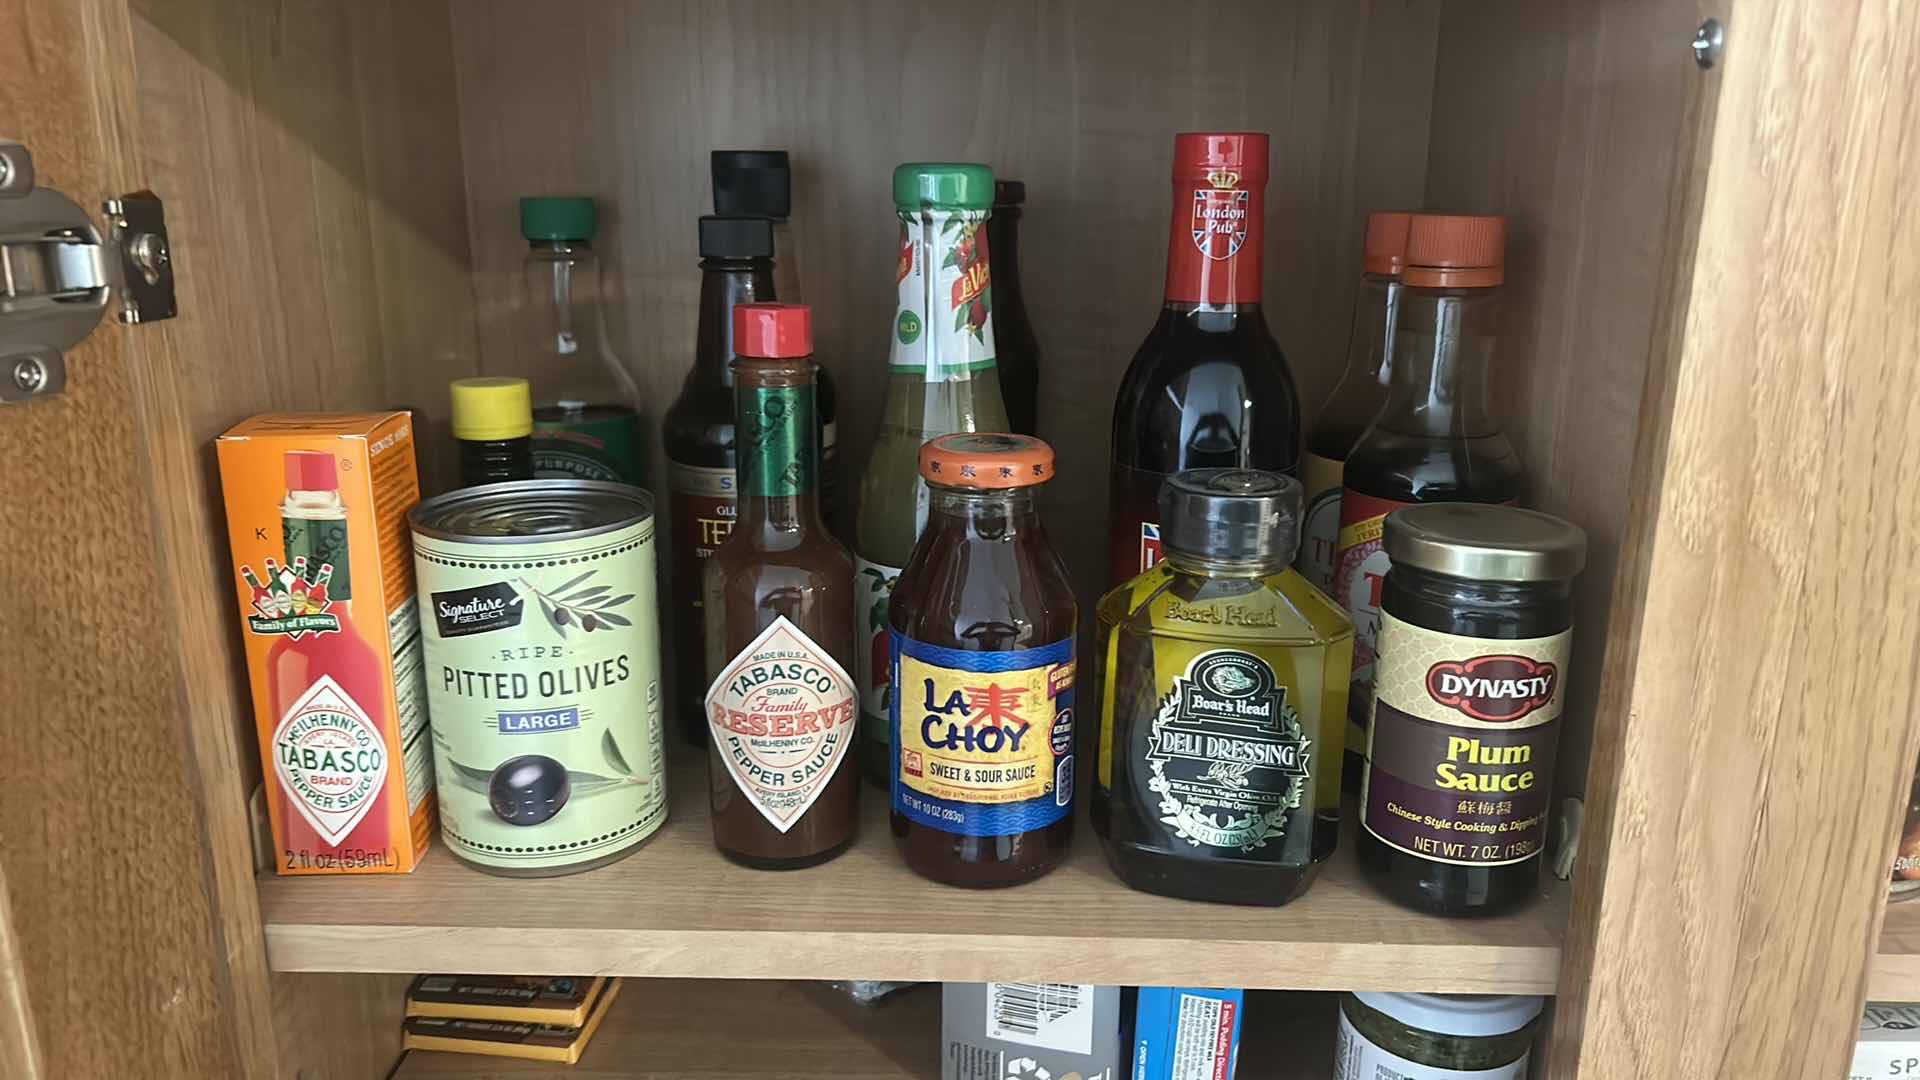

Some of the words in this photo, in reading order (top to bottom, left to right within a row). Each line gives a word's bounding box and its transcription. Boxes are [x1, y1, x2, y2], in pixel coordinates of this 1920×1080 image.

[1197, 204, 1245, 220] London
[1208, 220, 1235, 234] Pub
[255, 528, 267, 540] K
[440, 597, 506, 624] Signature
[458, 609, 505, 623] SELECT
[252, 620, 286, 632] Family
[286, 618, 298, 628] of
[299, 616, 336, 628] Flavors
[501, 646, 564, 661] RIPE
[443, 666, 528, 700] PITTED
[539, 655, 630, 697] OLIVES
[729, 664, 832, 697] TABASCO
[1440, 673, 1552, 699] DYNASTY
[766, 688, 798, 696] BRAND
[923, 678, 971, 717] LA
[752, 696, 809, 714] Family
[1192, 694, 1234, 713] Boar's
[1235, 699, 1270, 717] Head
[505, 712, 573, 730] LARGE
[712, 698, 854, 738] RESERVE
[921, 715, 1031, 754] CHOY
[279, 742, 383, 774] TABASCO
[728, 736, 785, 786] PEPPER
[792, 733, 838, 784] SAUCE
[1161, 731, 1202, 755] DELI
[1206, 736, 1295, 766] DRESSING
[1446, 736, 1531, 765] Plum
[311, 775, 353, 787] BRAND
[930, 761, 962, 781] SWEET
[964, 769, 972, 782] &
[975, 769, 1003, 783] SOUR
[1005, 764, 1036, 782] SAUCE
[1435, 763, 1535, 792] Sauce
[289, 768, 334, 809] PEPPER
[340, 776, 374, 809] SAUCE
[1213, 788, 1238, 799] Virgin
[1386, 801, 1423, 823] Chinese
[1423, 815, 1452, 831] Style
[1453, 820, 1498, 835] Cooking
[1498, 823, 1507, 832] &
[285, 850, 296, 869] 2
[315, 854, 335, 869] oz
[1414, 835, 1441, 854] NET
[1442, 842, 1466, 858] WT.
[1471, 845, 1479, 859] 7
[1216, 1026, 1230, 1057] Pudding
